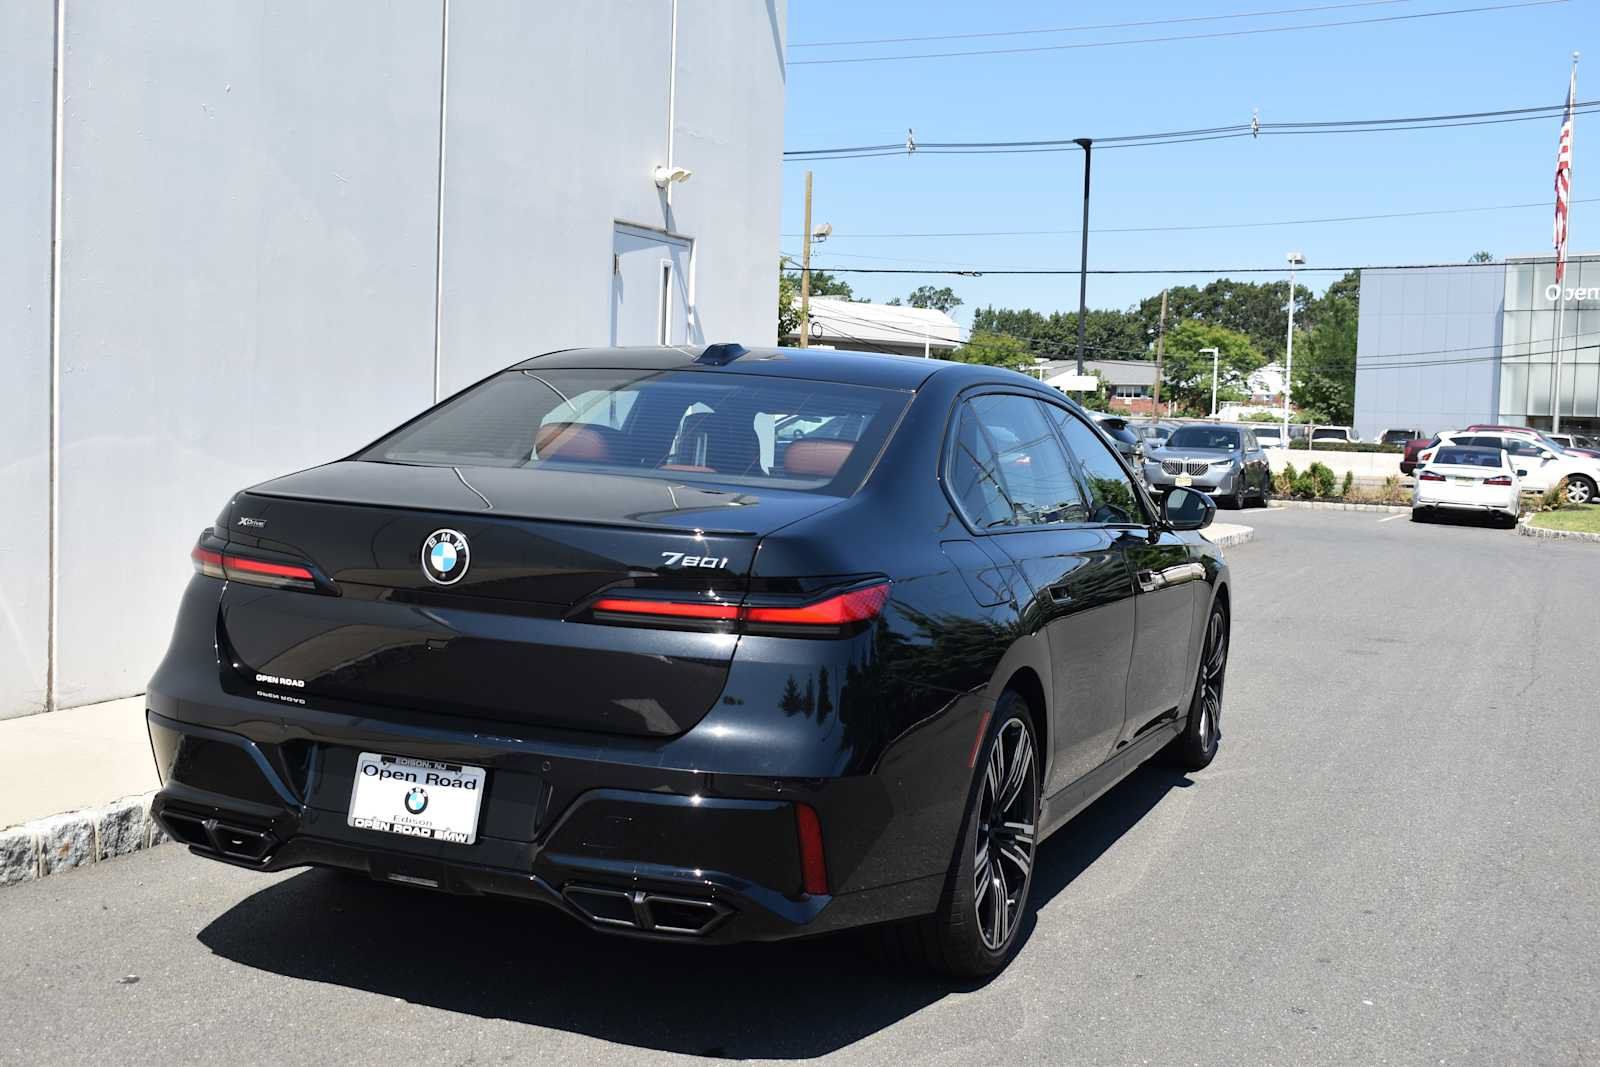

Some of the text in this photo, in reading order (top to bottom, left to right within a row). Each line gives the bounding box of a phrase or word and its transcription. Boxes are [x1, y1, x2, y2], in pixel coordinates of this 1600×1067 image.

[428, 532, 464, 551] BMW
[256, 674, 305, 688] OPEN ROAD
[363, 764, 477, 790] Open Road
[355, 818, 468, 843] OPEN ROAD BMW
[392, 815, 433, 827] Edison
